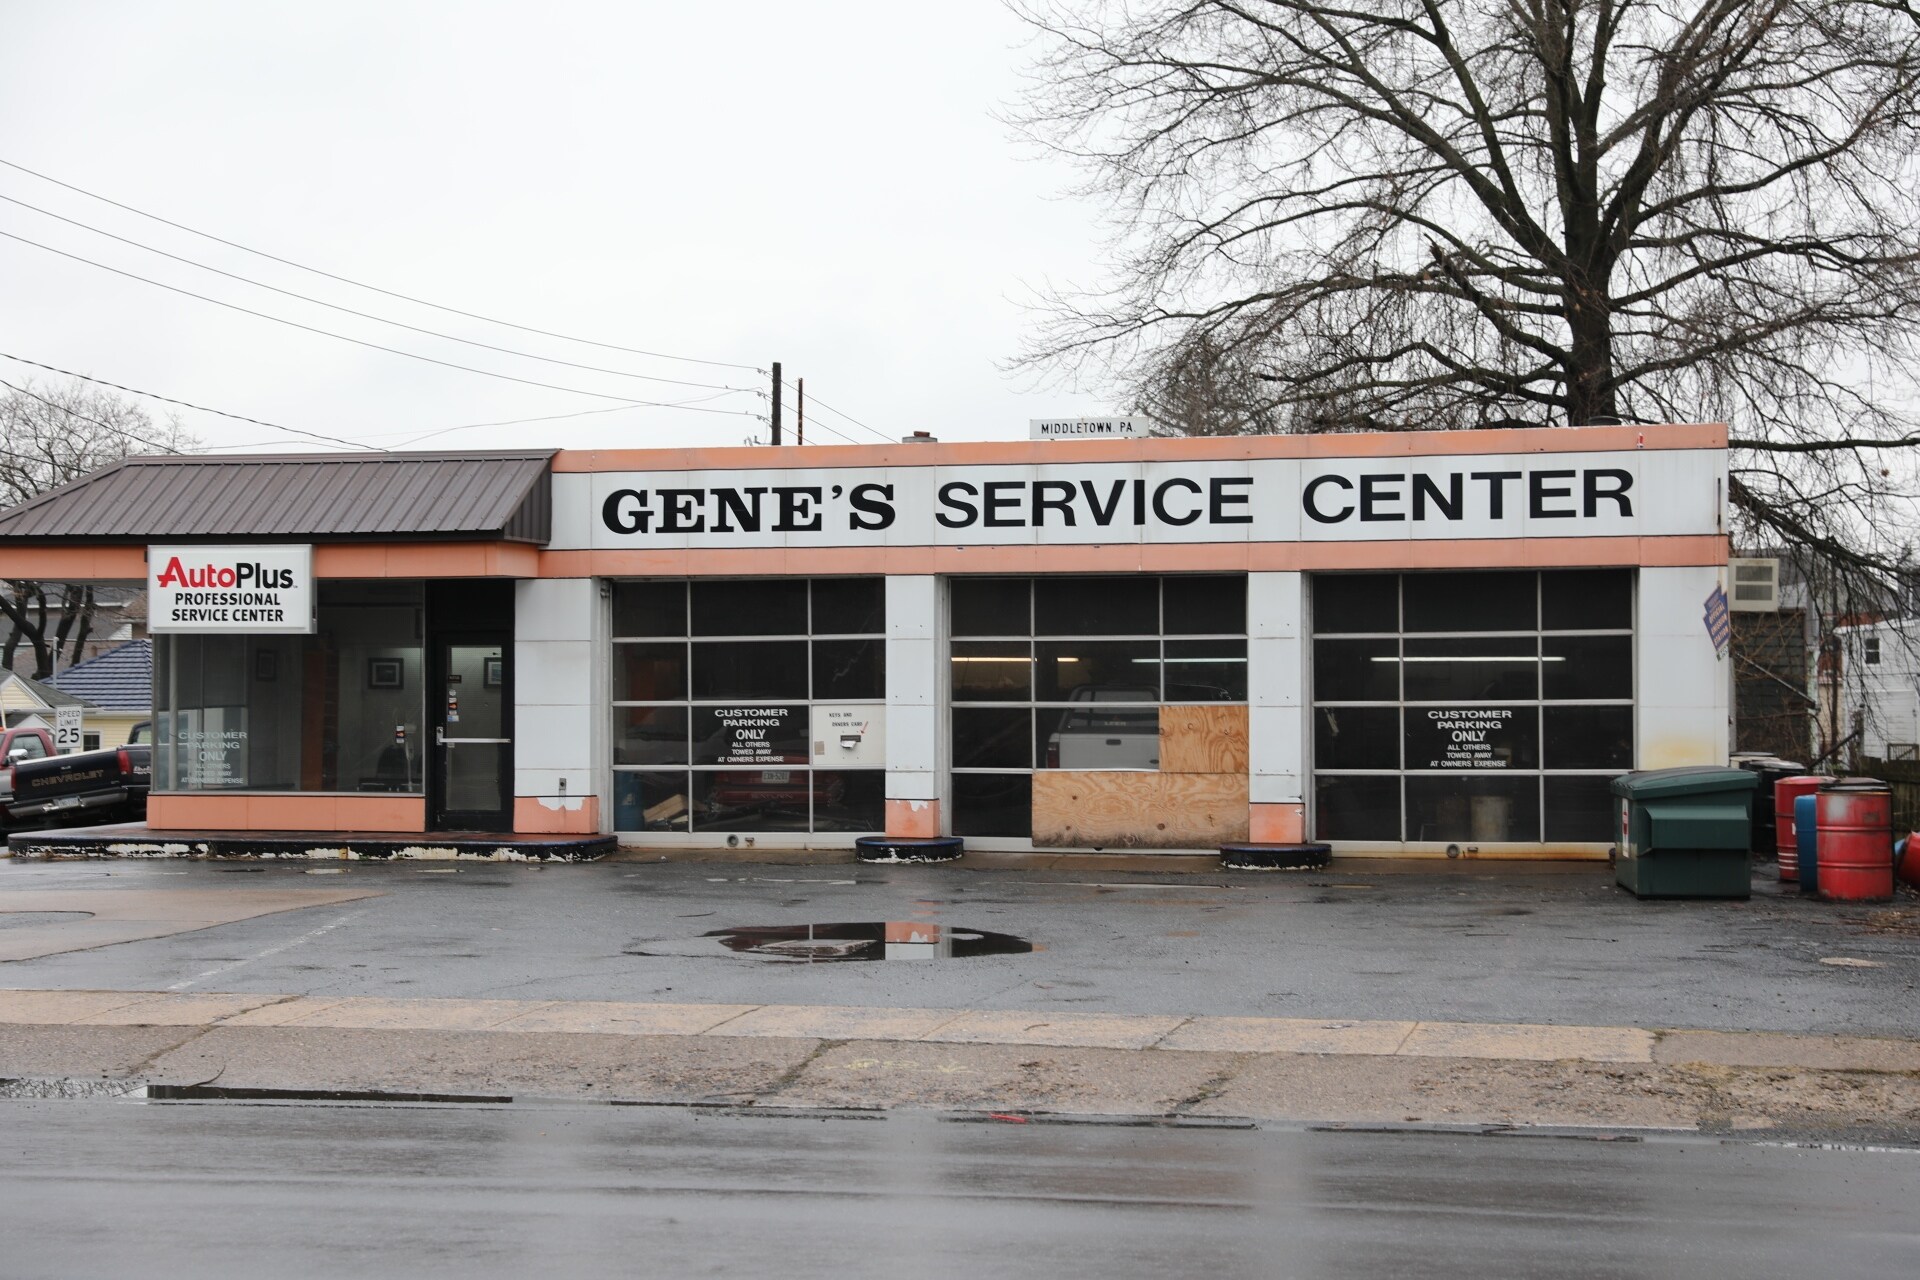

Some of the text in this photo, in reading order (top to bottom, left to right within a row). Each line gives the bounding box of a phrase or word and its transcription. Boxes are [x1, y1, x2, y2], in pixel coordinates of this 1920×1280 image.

[602, 468, 1633, 534] GENE'S SERVICE CENTER
[157, 556, 294, 589] AutoPlus
[175, 593, 280, 605] PROFESSIONAL
[172, 609, 284, 622] SERVICE CENTER
[58, 710, 80, 718] SPEED
[714, 708, 788, 717] CUSTOMER
[1427, 710, 1513, 719] CUSTOMER
[723, 719, 780, 727] PARKING
[1437, 720, 1502, 729] PARKING
[58, 728, 80, 743] 25
[178, 731, 248, 740] CUSTOMER
[735, 728, 766, 740] ONLY
[1451, 730, 1487, 742] ONLY
[187, 741, 240, 749] PARKING
[1447, 743, 1491, 751] ALL OTHERS
[199, 751, 227, 762] ONLY
[726, 755, 754, 763] OWNERS
[755, 755, 785, 763] EXPENSE
[1430, 760, 1507, 768] AT OWNERS EXPENSE
[31, 769, 104, 787] CHEVROLET
